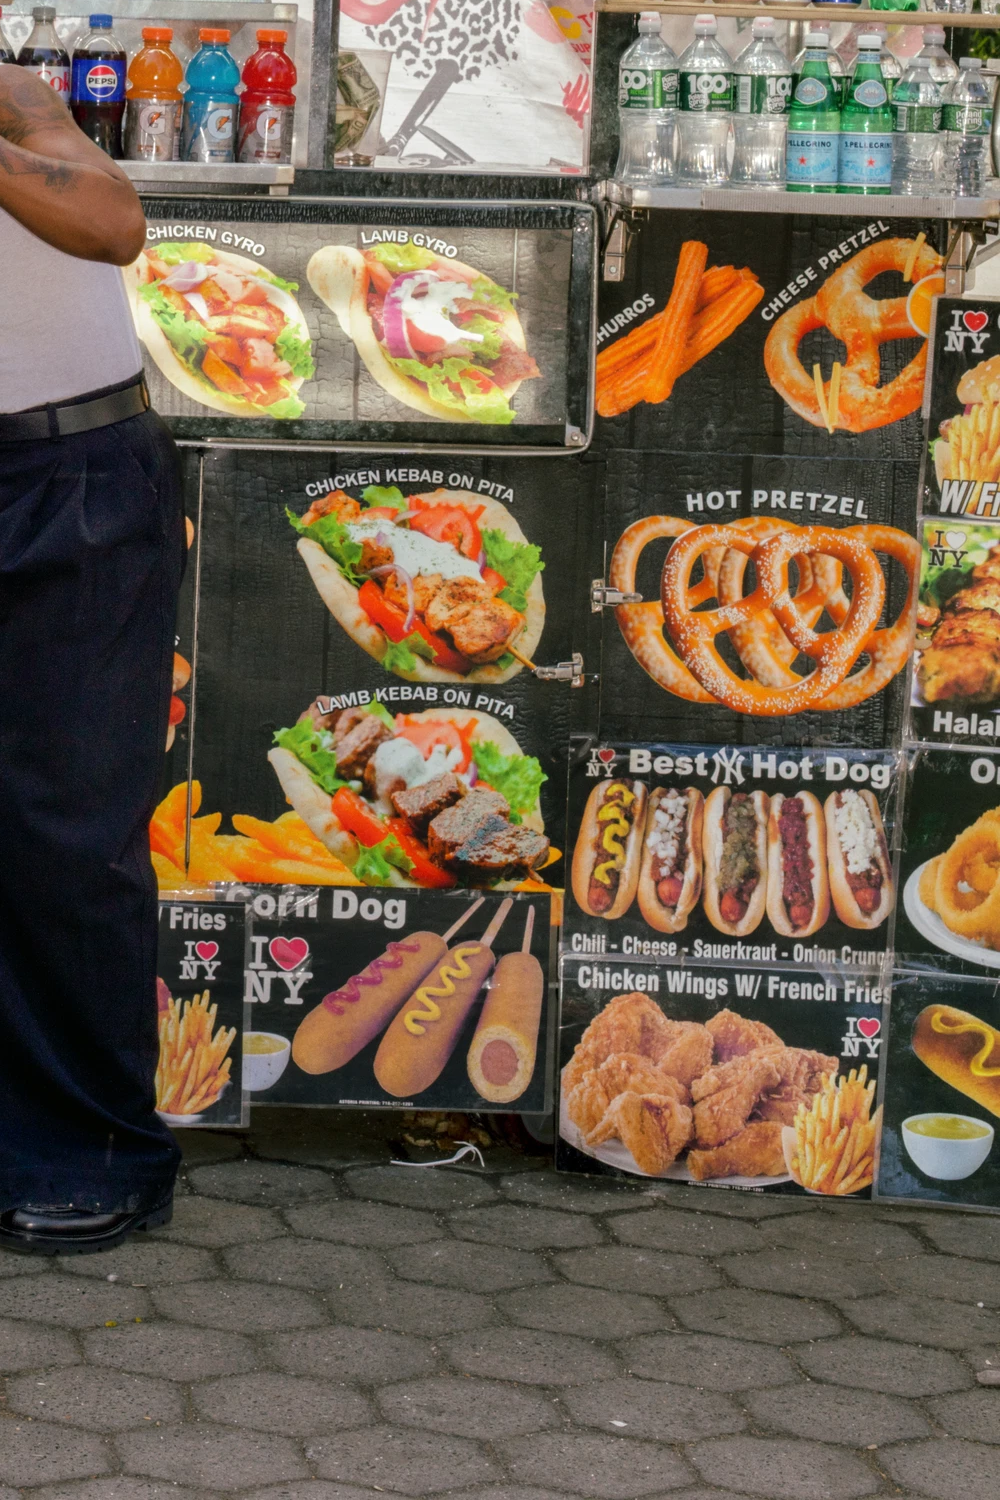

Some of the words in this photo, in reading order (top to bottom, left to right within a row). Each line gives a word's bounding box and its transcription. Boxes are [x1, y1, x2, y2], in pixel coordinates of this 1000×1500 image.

[87, 76, 116, 85] PEPSI
[140, 105, 166, 135] G
[207, 108, 233, 140] G
[256, 110, 282, 140] G
[146, 225, 217, 241] CHICKEN
[220, 231, 266, 258] GYRO
[360, 231, 409, 244] LAMB
[412, 233, 458, 259] GYRO
[761, 268, 817, 322] CHEESE
[817, 219, 890, 271] PRETZEL
[596, 293, 655, 345] HURROS
[944, 331, 990, 354] NY
[305, 468, 381, 498] CHICKEN
[385, 468, 444, 484] KEBAB
[448, 472, 474, 490] ON
[479, 478, 516, 503] PITA
[685, 490, 743, 513] HOT
[752, 490, 869, 520] PRETZEL
[317, 689, 371, 716] LAMB
[375, 686, 438, 702] KEBAB
[444, 688, 470, 705] ON
[475, 693, 515, 720] PITA
[586, 762, 618, 778] NY
[628, 749, 708, 775] Best
[752, 757, 814, 780] Hot
[825, 757, 891, 790] Dog
[169, 906, 227, 931] Fries
[332, 890, 407, 929] Dog
[571, 932, 606, 954] Chili
[622, 936, 677, 958] Cheese
[693, 938, 777, 962] Sauerkraut
[793, 946, 836, 964] Onion
[179, 960, 221, 981] NY
[577, 965, 659, 991] Chicken
[667, 970, 728, 997] Wings
[767, 975, 837, 1002] French
[843, 980, 892, 1005] Fries
[243, 969, 313, 1005] NY
[841, 1037, 882, 1058] NY
